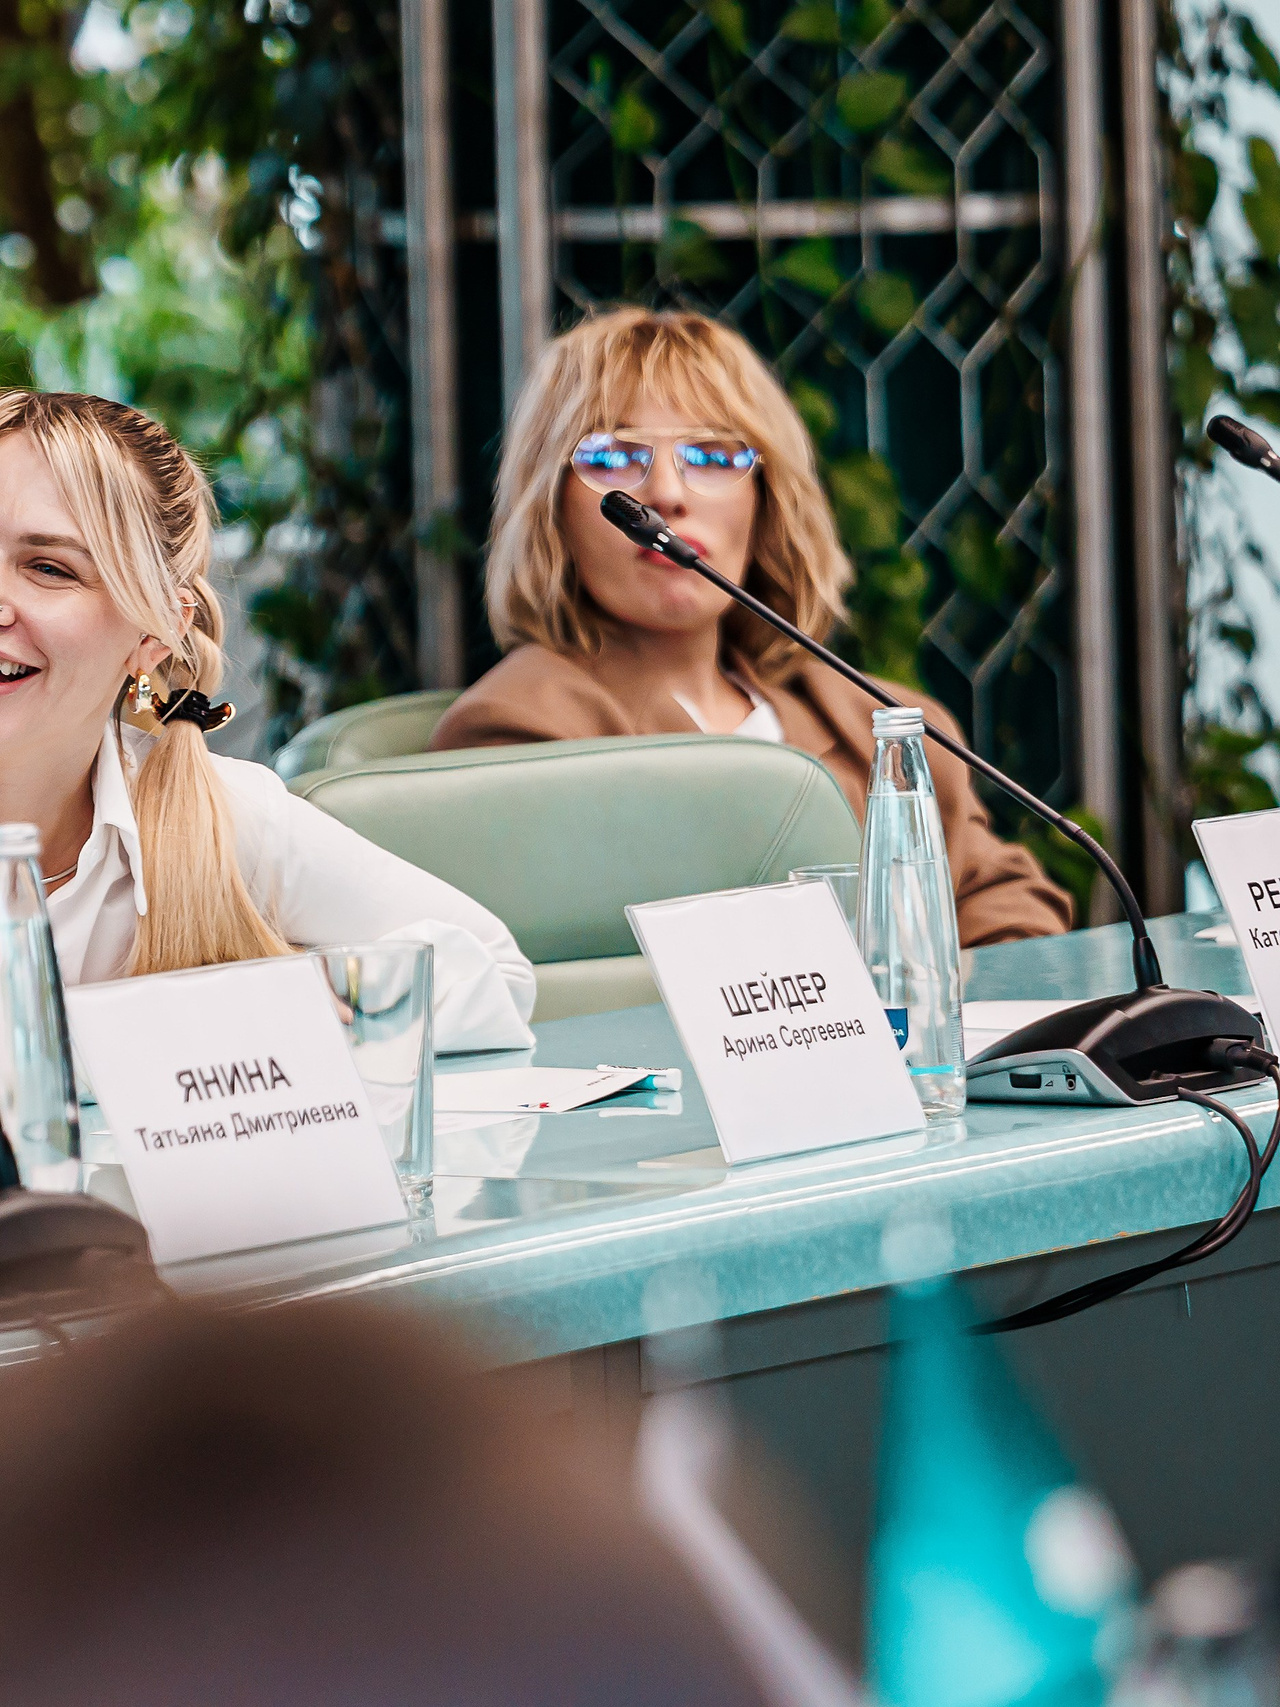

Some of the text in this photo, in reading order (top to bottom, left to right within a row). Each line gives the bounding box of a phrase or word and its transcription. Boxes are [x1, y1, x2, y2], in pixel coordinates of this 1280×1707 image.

[1247, 877, 1280, 912] РЕ
[1248, 927, 1280, 950] Кат
[719, 971, 827, 1018] ШЕЙДЕР
[722, 1018, 866, 1062] Арина Сергеевна
[175, 1056, 292, 1103] ЯНИНА
[134, 1100, 359, 1152] Татьяна Дмитриевна
